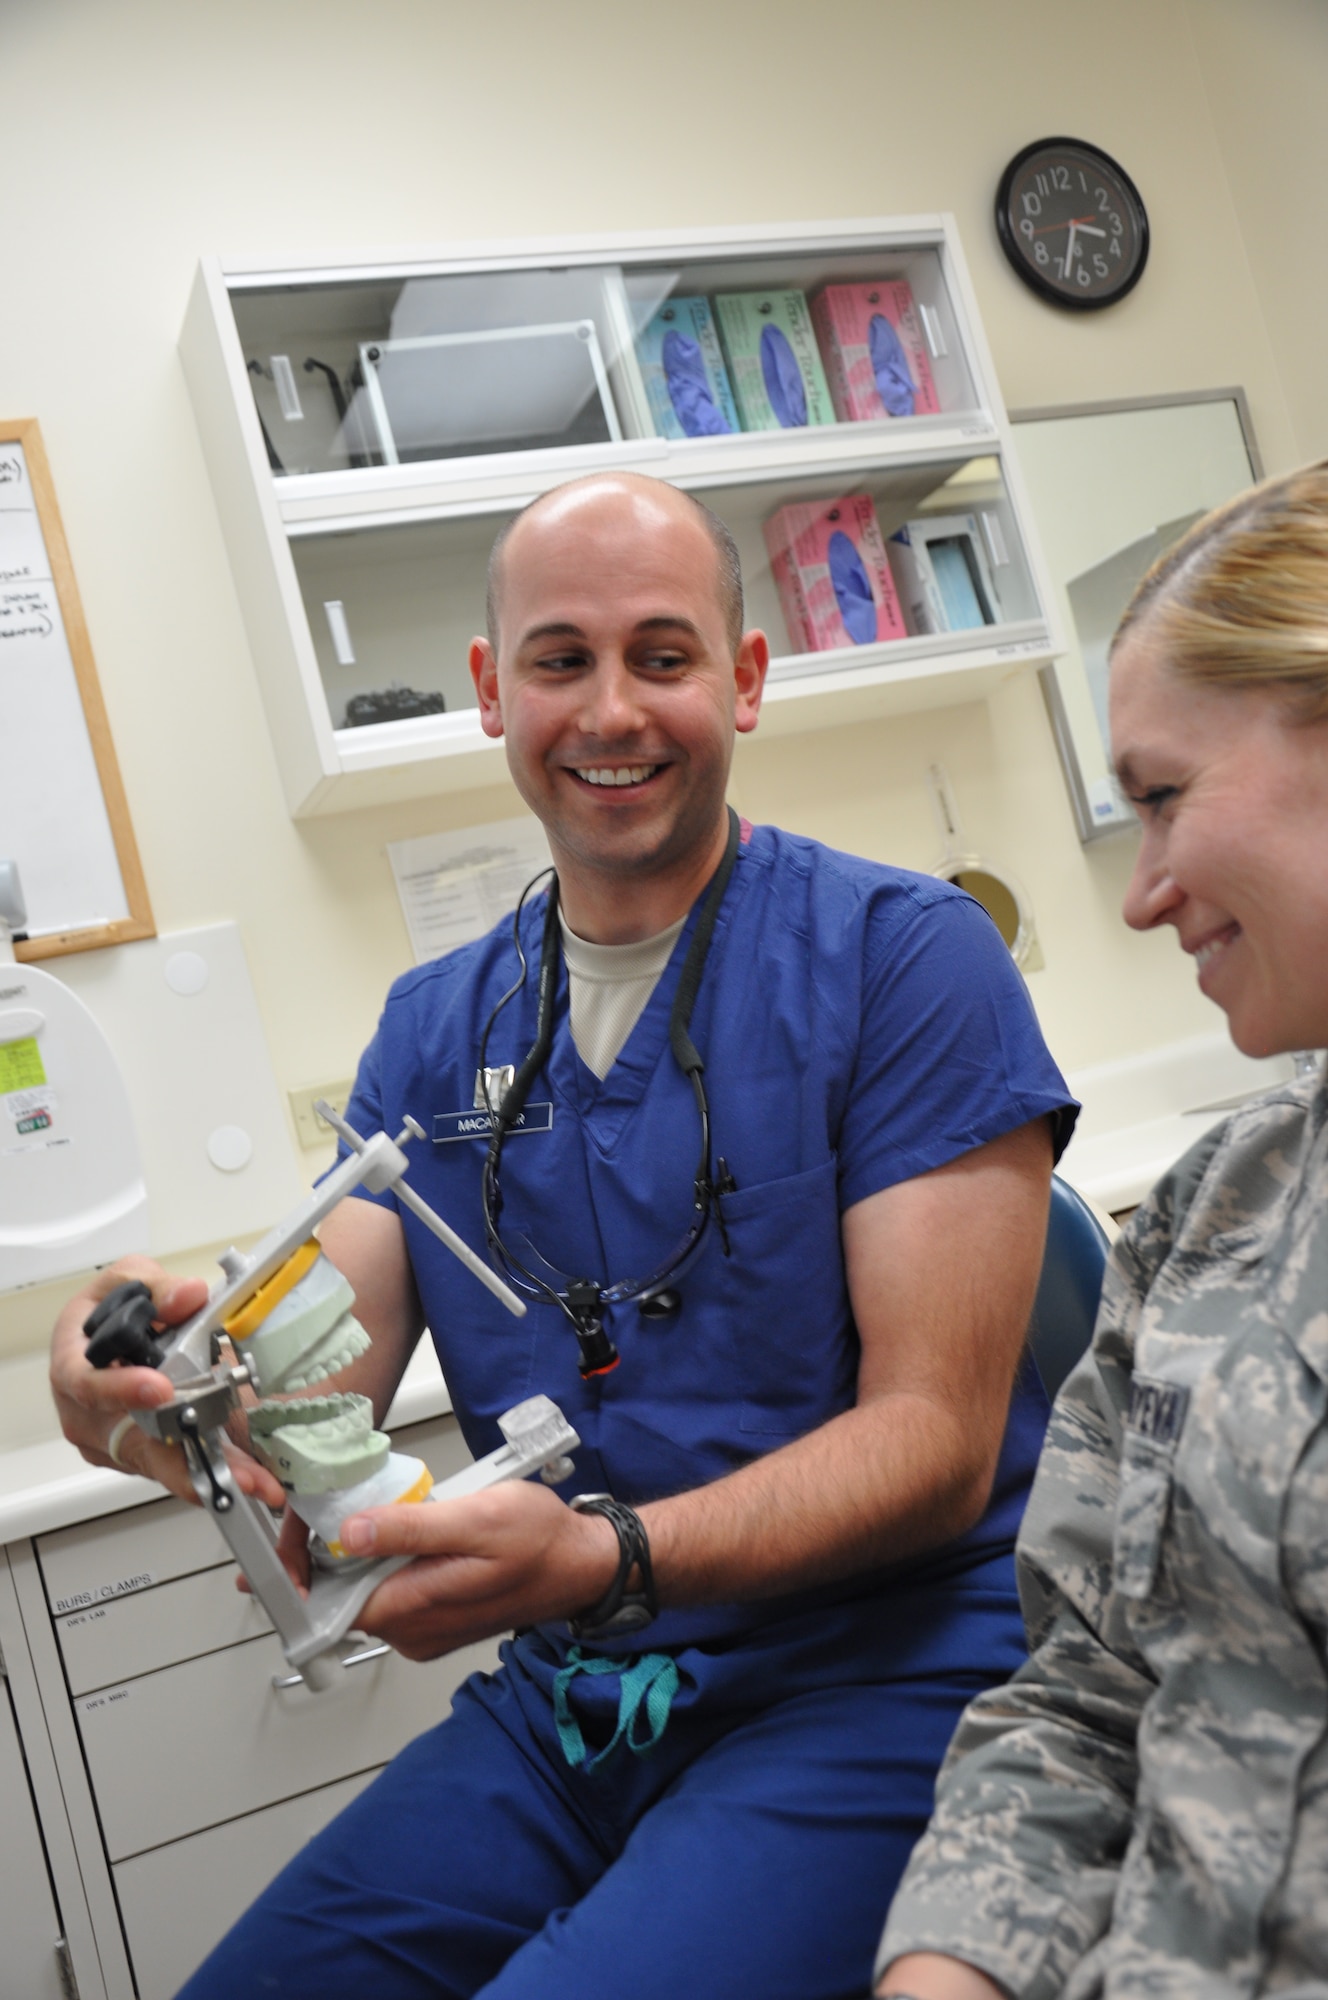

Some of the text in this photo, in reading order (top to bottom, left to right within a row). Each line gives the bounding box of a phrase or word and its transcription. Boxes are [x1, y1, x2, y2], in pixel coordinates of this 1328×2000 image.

[1036, 173, 1050, 197] 11
[1050, 166, 1072, 190] 12
[1078, 171, 1088, 193] 1
[1021, 192, 1042, 216] 10
[1095, 187, 1111, 211] 2
[1020, 218, 1034, 241] 9
[1109, 212, 1123, 236] 3
[1034, 241, 1049, 265] 8
[1109, 238, 1122, 258] 4
[1053, 256, 1066, 281] 7
[1076, 264, 1091, 287] 6
[1093, 253, 1108, 278] 5
[56, 1592, 92, 1611] BURS
[100, 1573, 152, 1597] CLAMPS
[89, 1610, 106, 1621] LAB
